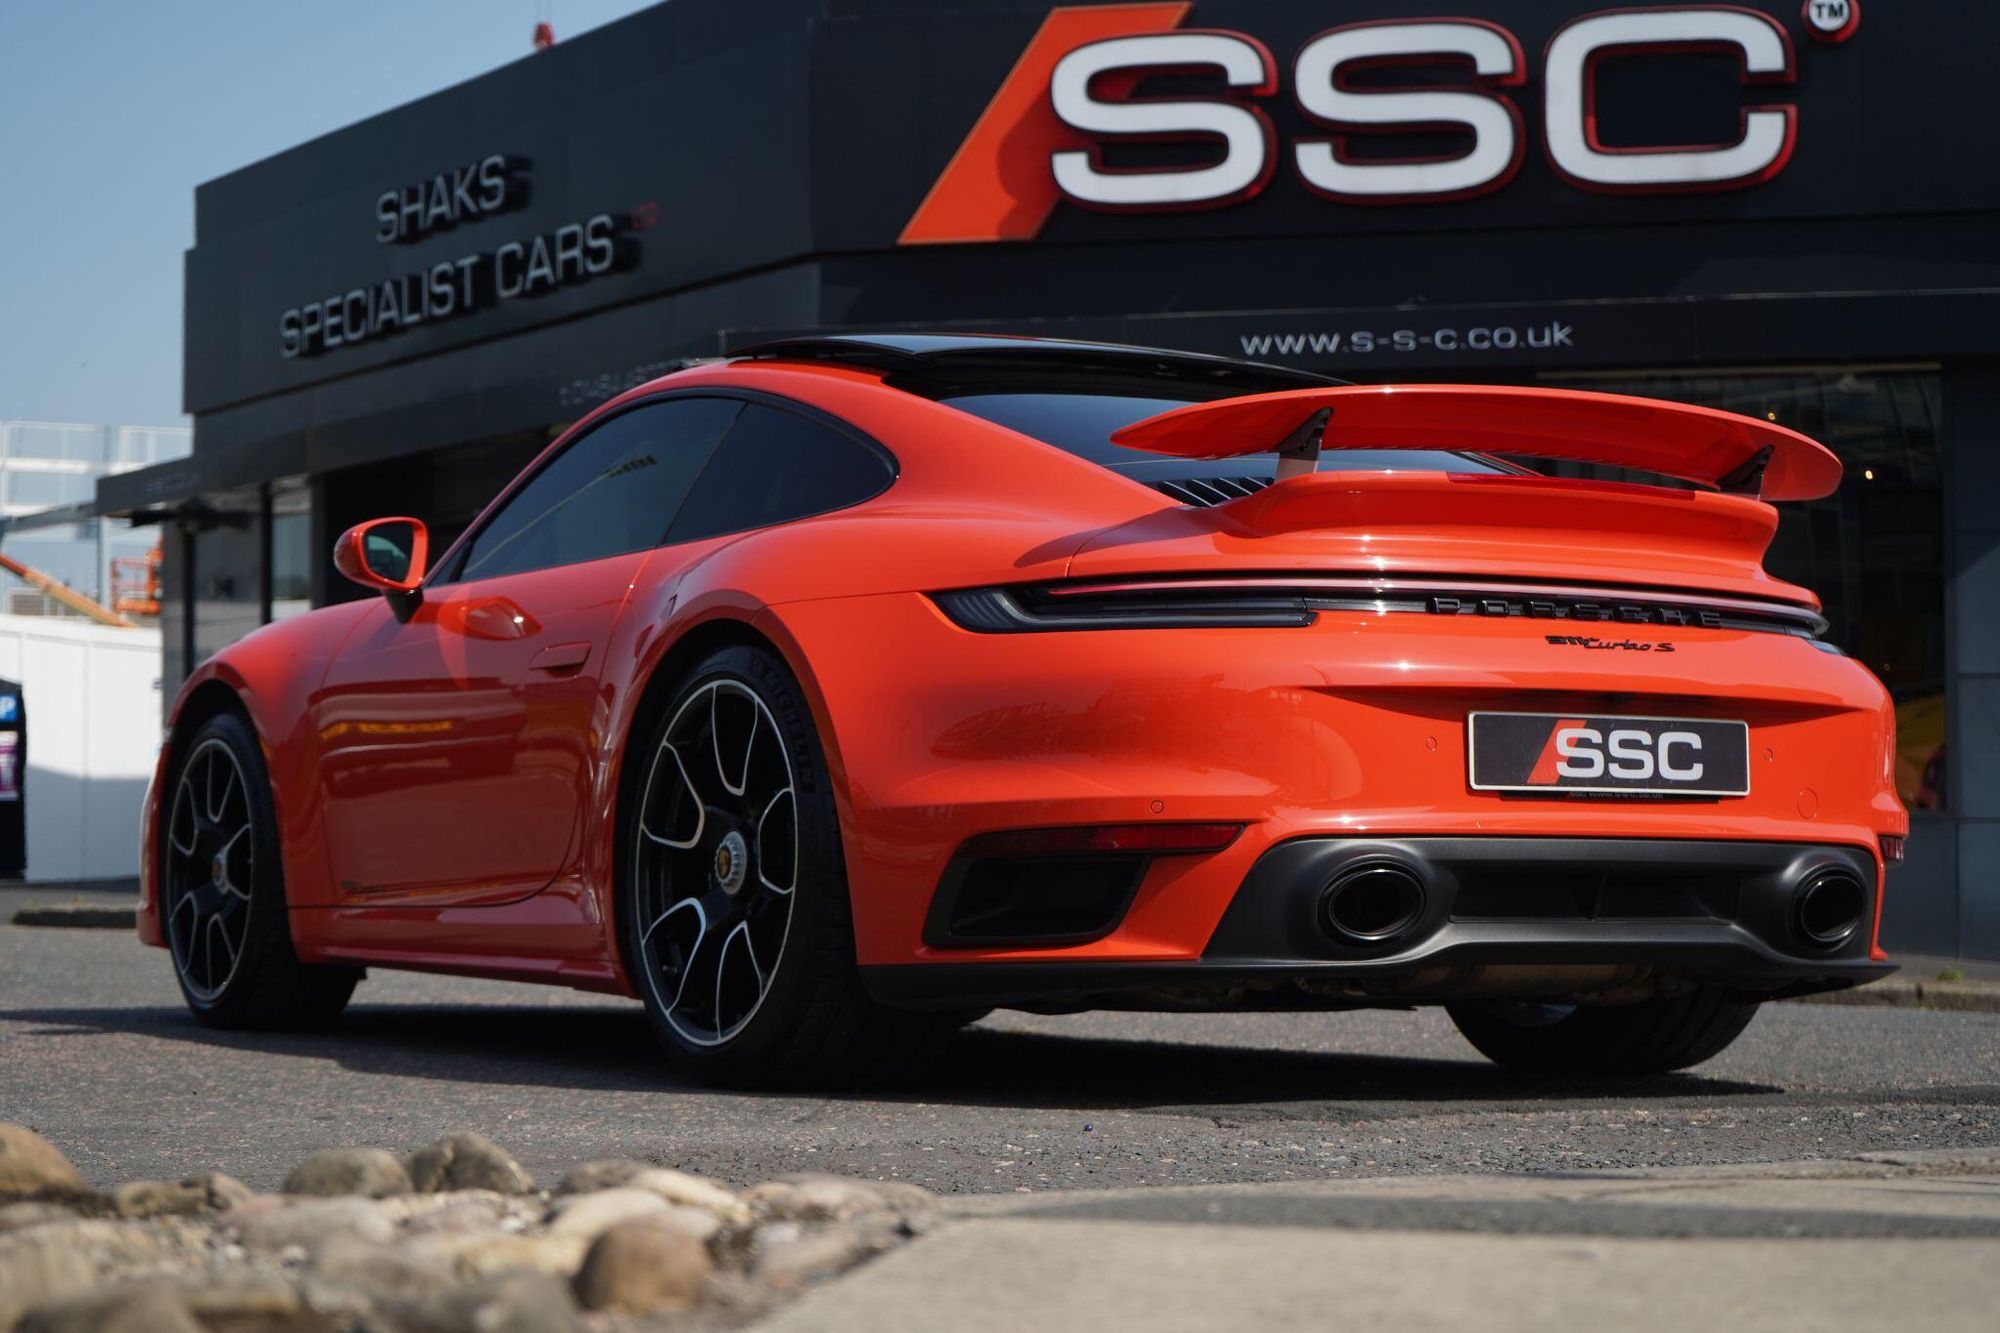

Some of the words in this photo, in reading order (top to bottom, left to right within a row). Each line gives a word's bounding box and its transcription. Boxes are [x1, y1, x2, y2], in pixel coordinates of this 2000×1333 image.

[1815, 4, 1843, 17] TM
[1051, 11, 1786, 203] SSC
[376, 154, 506, 244] SHAKS
[279, 255, 481, 358] SPECIALIST
[495, 214, 614, 298] CARS
[1240, 320, 1575, 356] www.s-s-c.co.uk
[1432, 597, 1722, 626] PORSCHE
[1556, 728, 1704, 781] SSC
